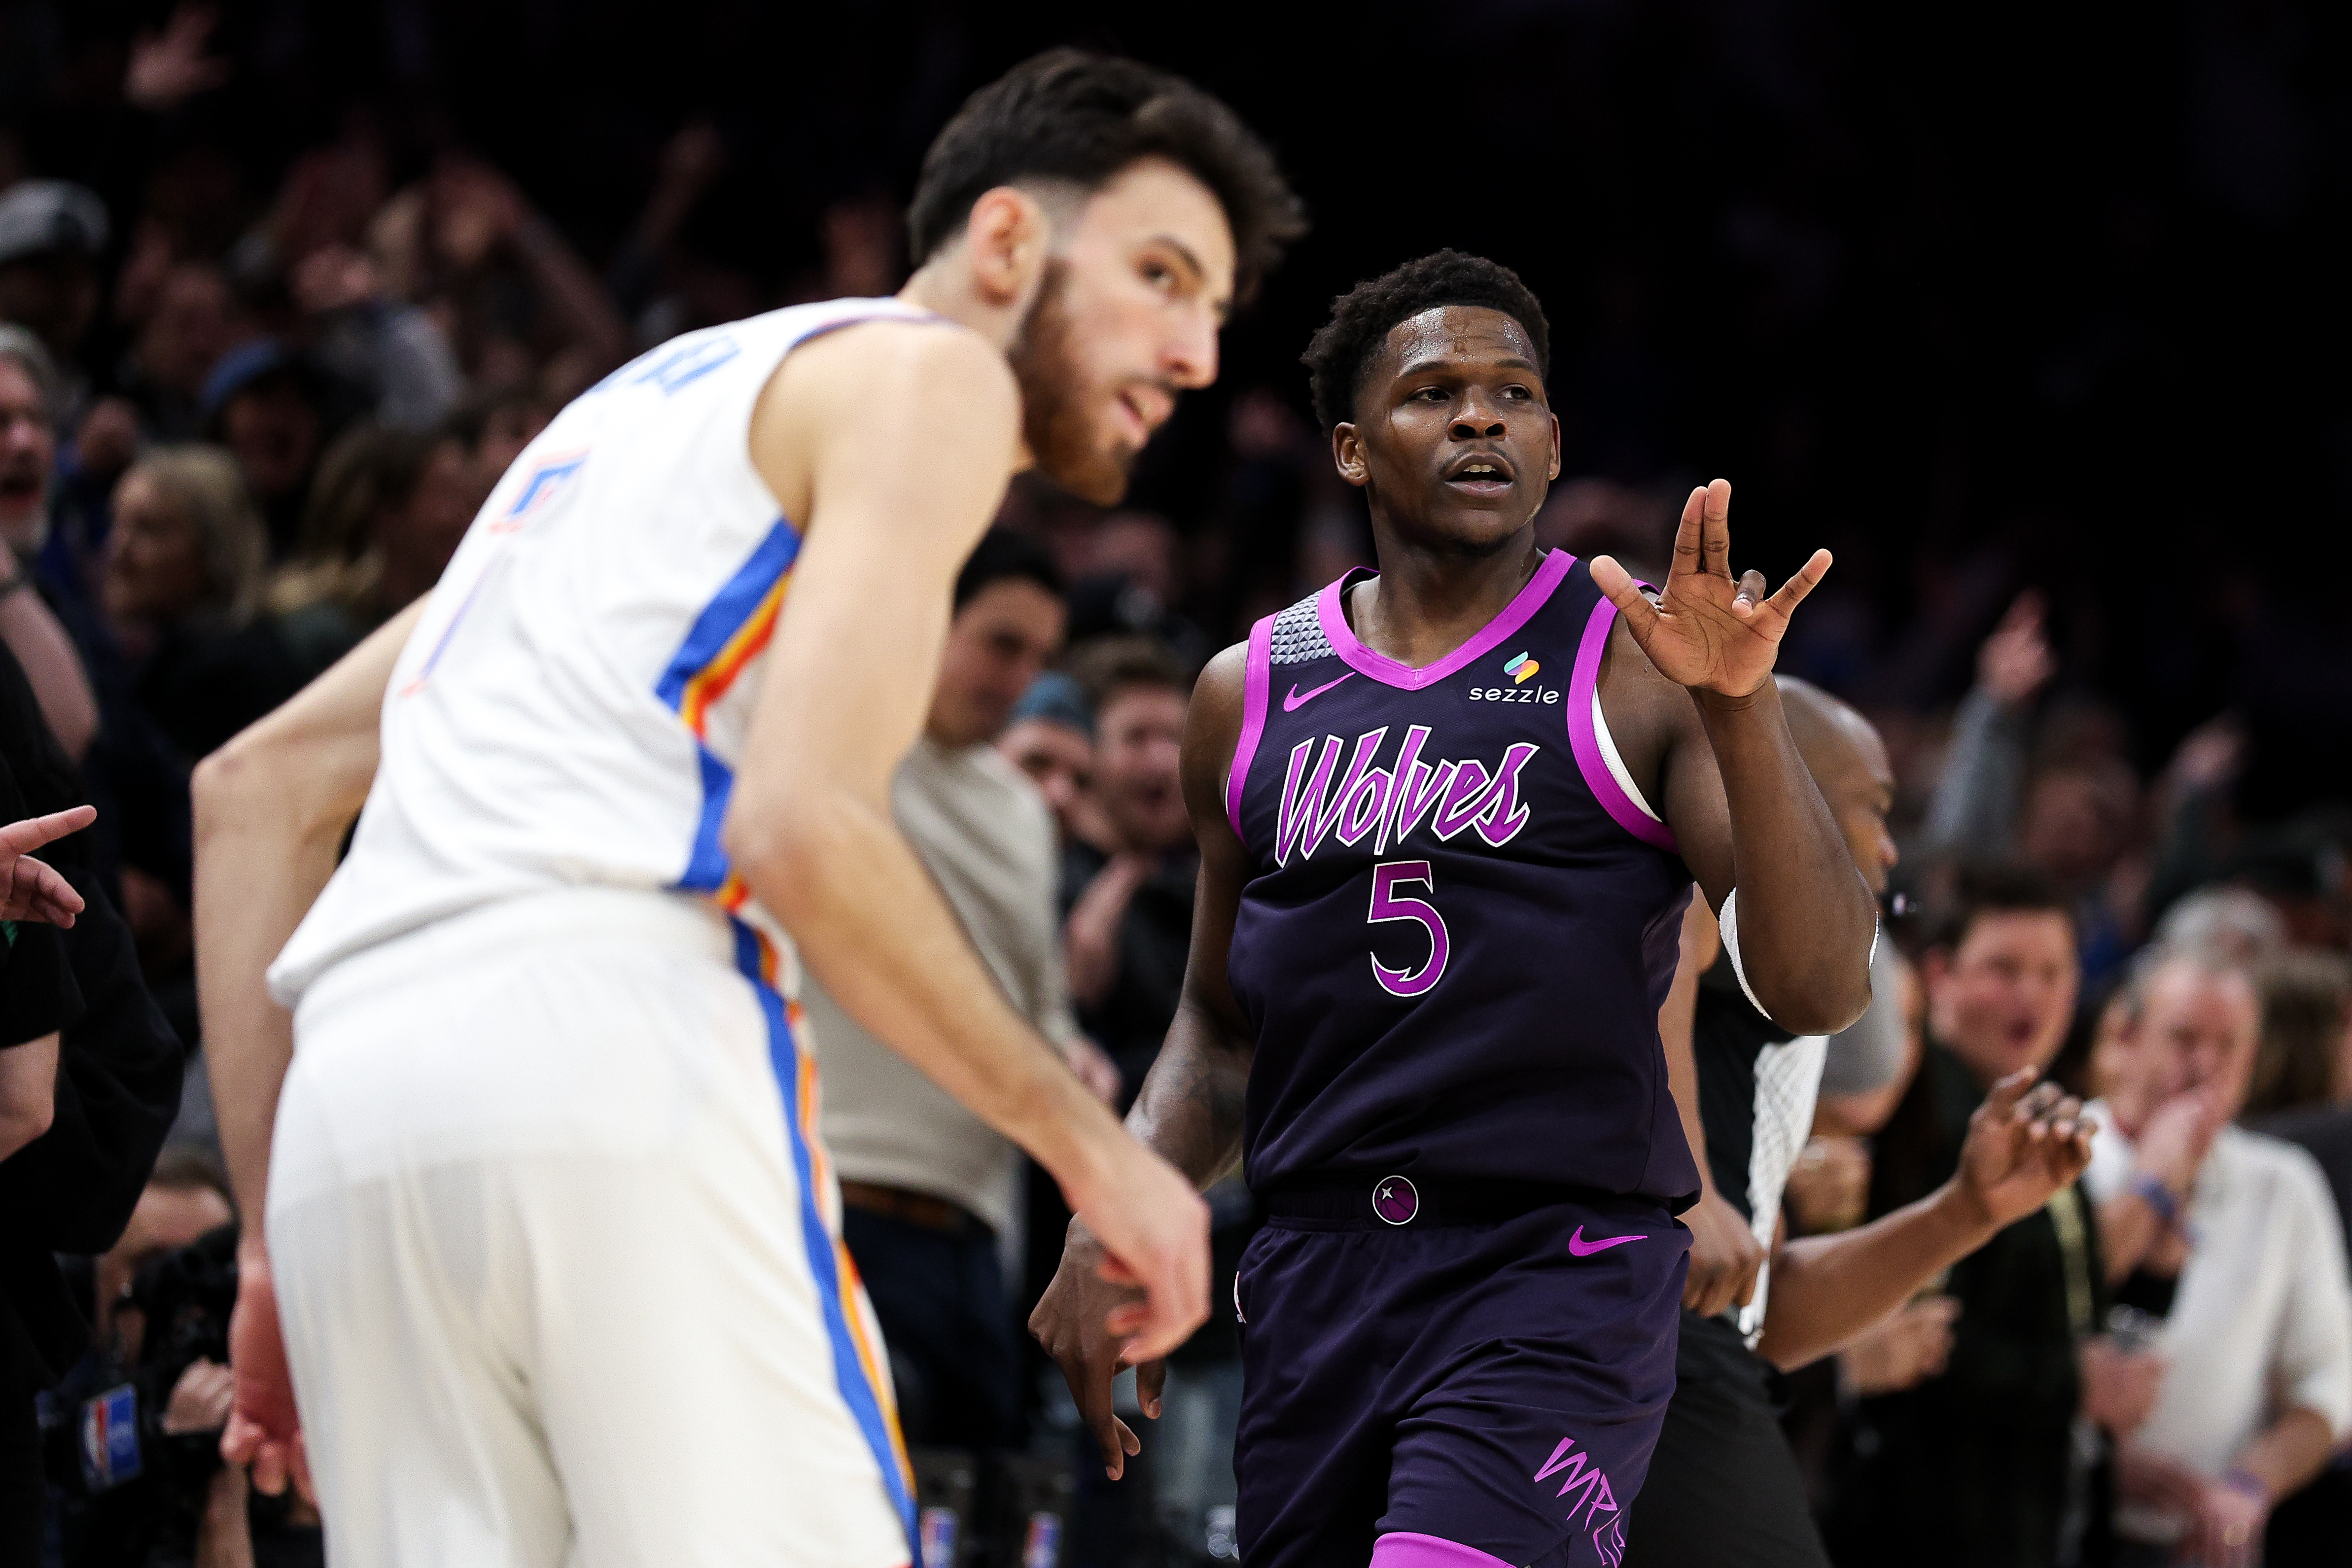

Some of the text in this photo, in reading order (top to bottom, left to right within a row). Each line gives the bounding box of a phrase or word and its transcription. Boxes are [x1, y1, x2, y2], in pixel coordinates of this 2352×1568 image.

[1469, 684, 1559, 704] sezzle
[1275, 724, 1540, 870] Wolves
[1367, 860, 1450, 997] 5
